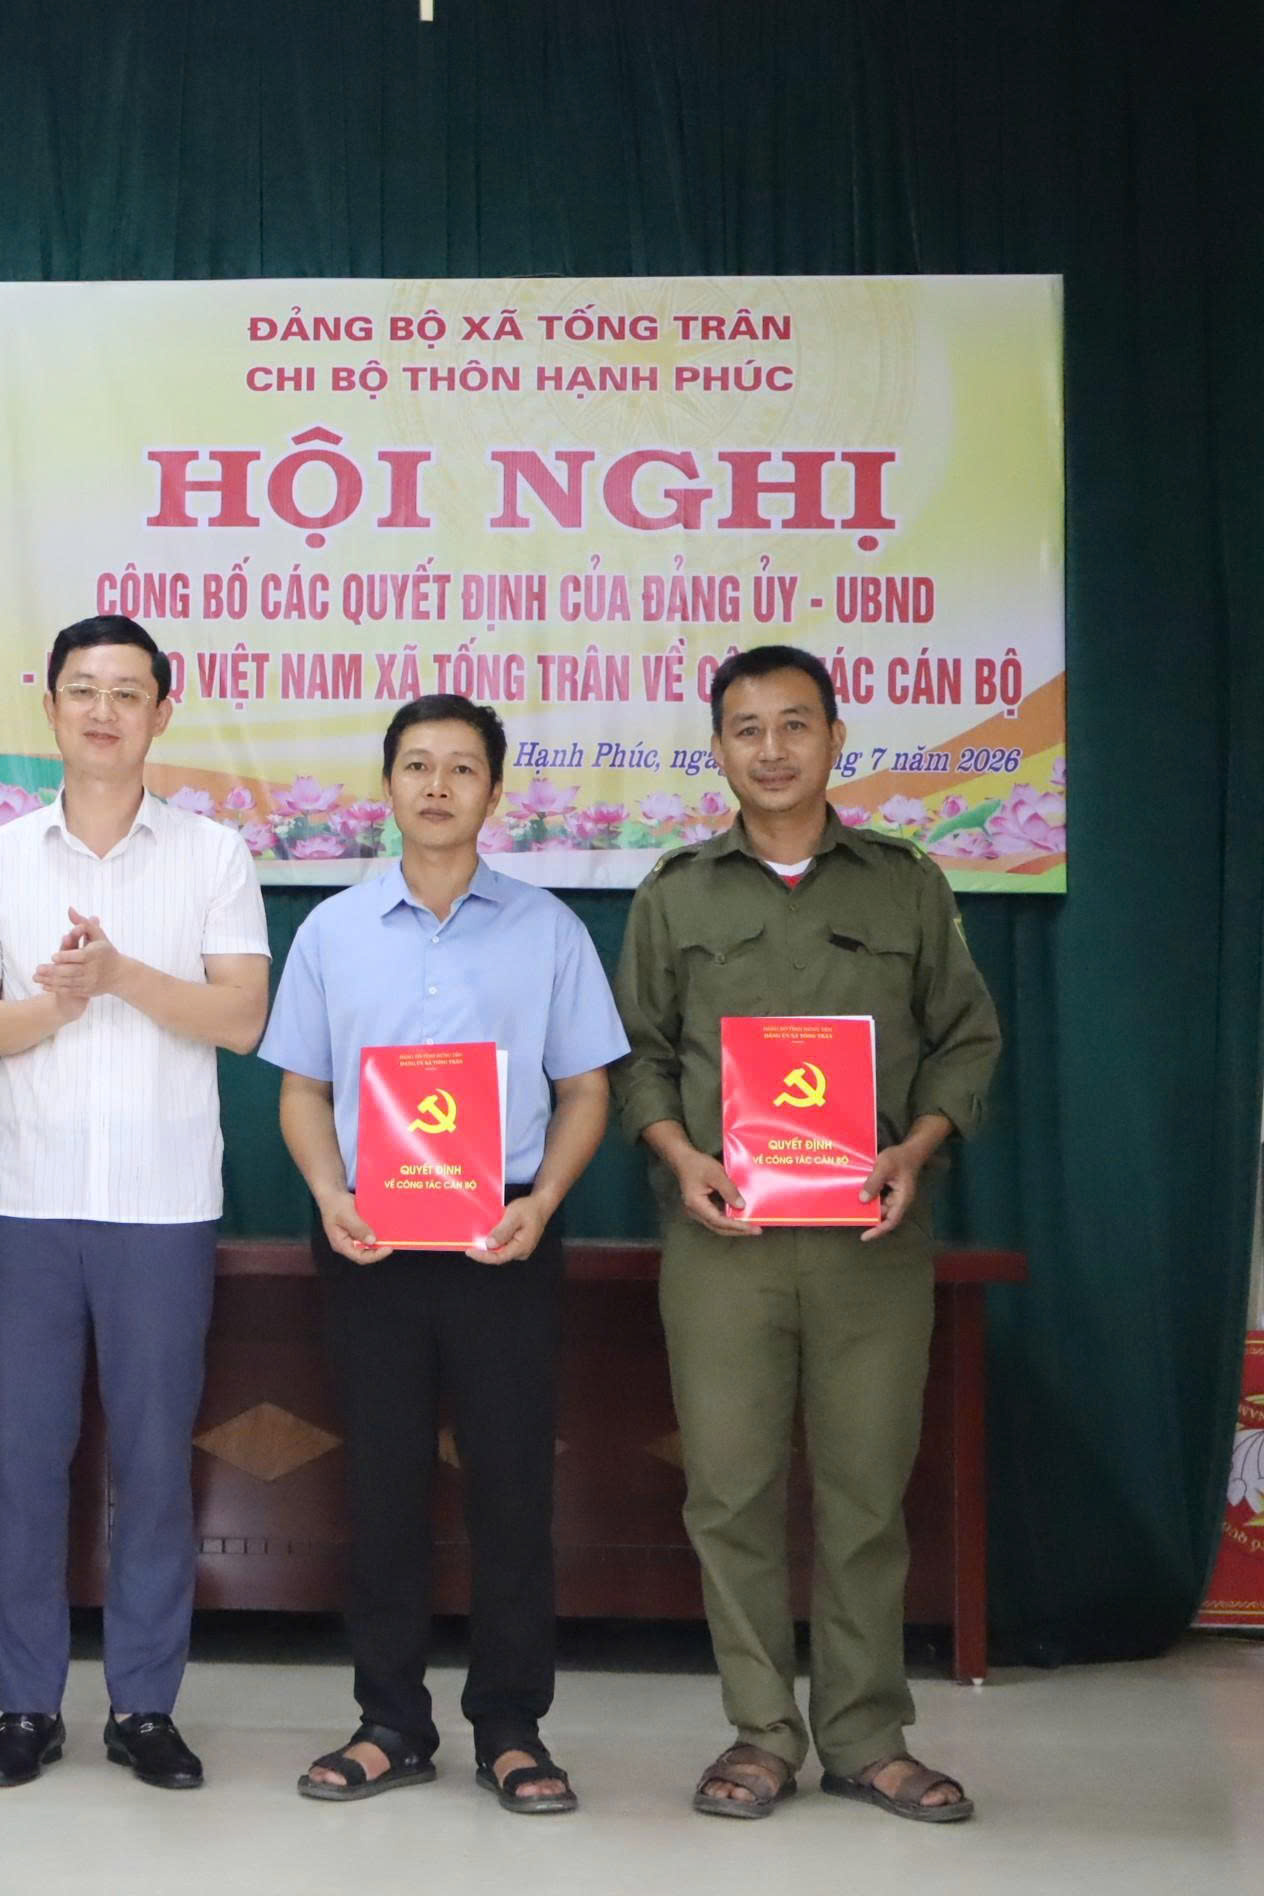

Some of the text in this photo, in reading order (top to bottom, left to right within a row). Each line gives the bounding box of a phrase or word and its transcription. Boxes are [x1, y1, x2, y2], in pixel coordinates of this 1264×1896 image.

[248, 304, 791, 349] ĐẢNG BỘ XÃ TỐNG TRÂN
[246, 360, 794, 399] CHI BỘ THÔN HẠNH PHÚC
[147, 426, 896, 552] HỘI NGHỊ
[97, 554, 934, 631] CÔNG BỐ CÁC QUYẾT ĐỊNH CỦA ĐẢNG ỦY - UBND
[197, 643, 270, 710] VIỆT
[281, 653, 362, 699] NAM
[375, 645, 421, 700] XÃ
[433, 637, 525, 700] TỐNG
[537, 645, 629, 701] TRÂN
[642, 638, 685, 702] VỀ
[888, 648, 961, 704] CÁN
[976, 648, 1023, 716] BỘ
[513, 742, 583, 775] Hạnh
[591, 738, 661, 773] Phúc,
[670, 750, 727, 777] ngà
[871, 748, 887, 771] 7
[890, 744, 950, 772] năm
[961, 749, 1021, 773] 2026
